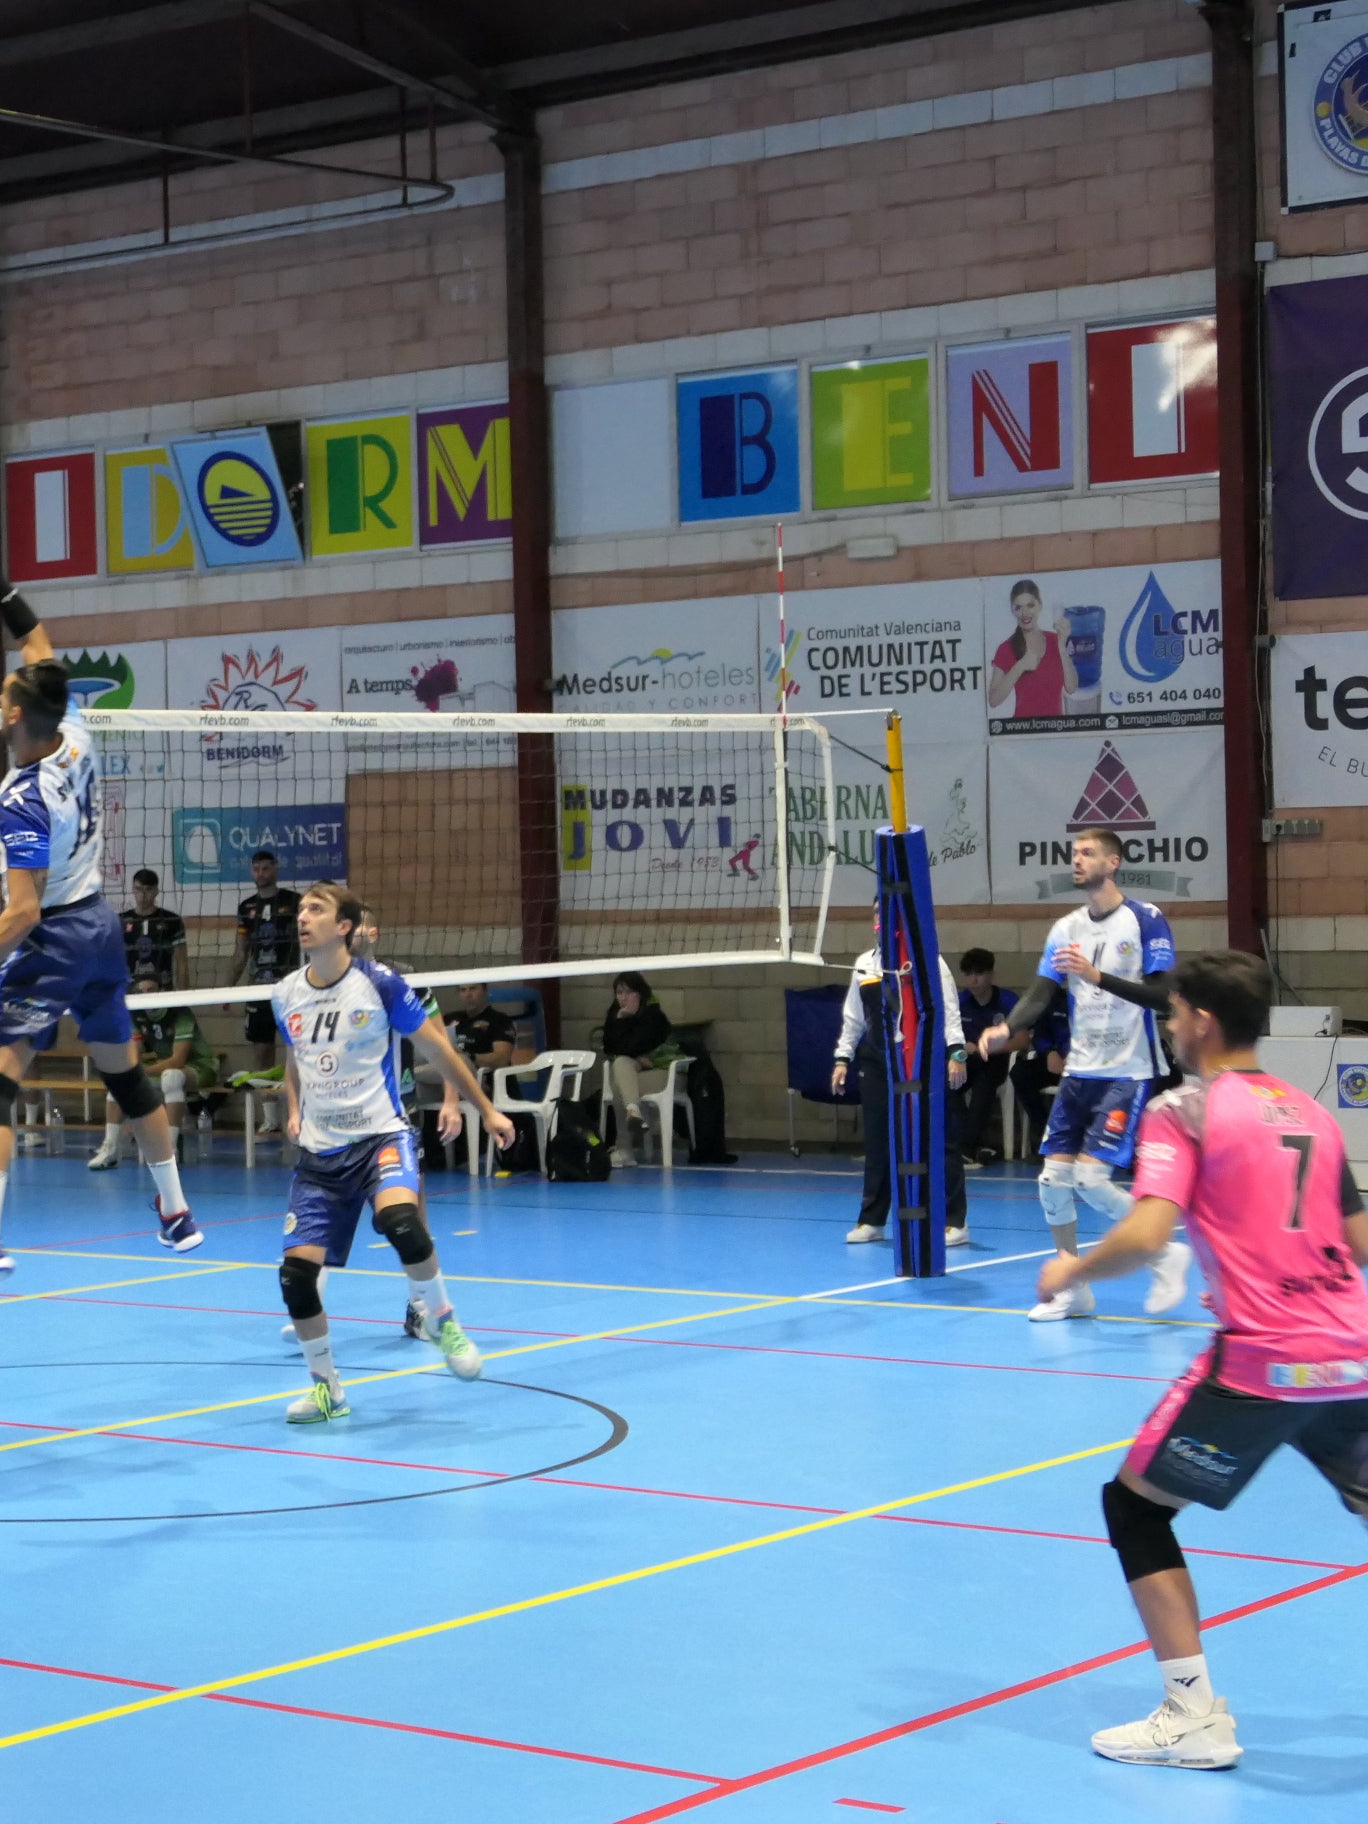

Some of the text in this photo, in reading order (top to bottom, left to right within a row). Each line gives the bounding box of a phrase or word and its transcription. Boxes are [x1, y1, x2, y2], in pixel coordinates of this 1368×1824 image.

[1324, 42, 1362, 84] CLUB
[1319, 119, 1359, 164] PLAYAS
[807, 620, 962, 641] Comunitat Valenciana
[1153, 609, 1220, 636] LCM
[807, 639, 962, 671] COMUNITAT
[1155, 637, 1219, 664] agua
[347, 677, 413, 695] A temps
[820, 675, 851, 698] DE
[1127, 688, 1221, 704] 651 404 040
[206, 745, 284, 761] BENIDORM
[1318, 746, 1338, 768] EL
[564, 783, 737, 811] MUDANZAS
[768, 783, 889, 822] ABRNA
[228, 822, 342, 850] QUALYNET
[568, 815, 732, 860] JOVI
[1018, 836, 1209, 866] PINCHIO
[311, 1011, 341, 1044] 14
[1281, 1134, 1316, 1231] 7
